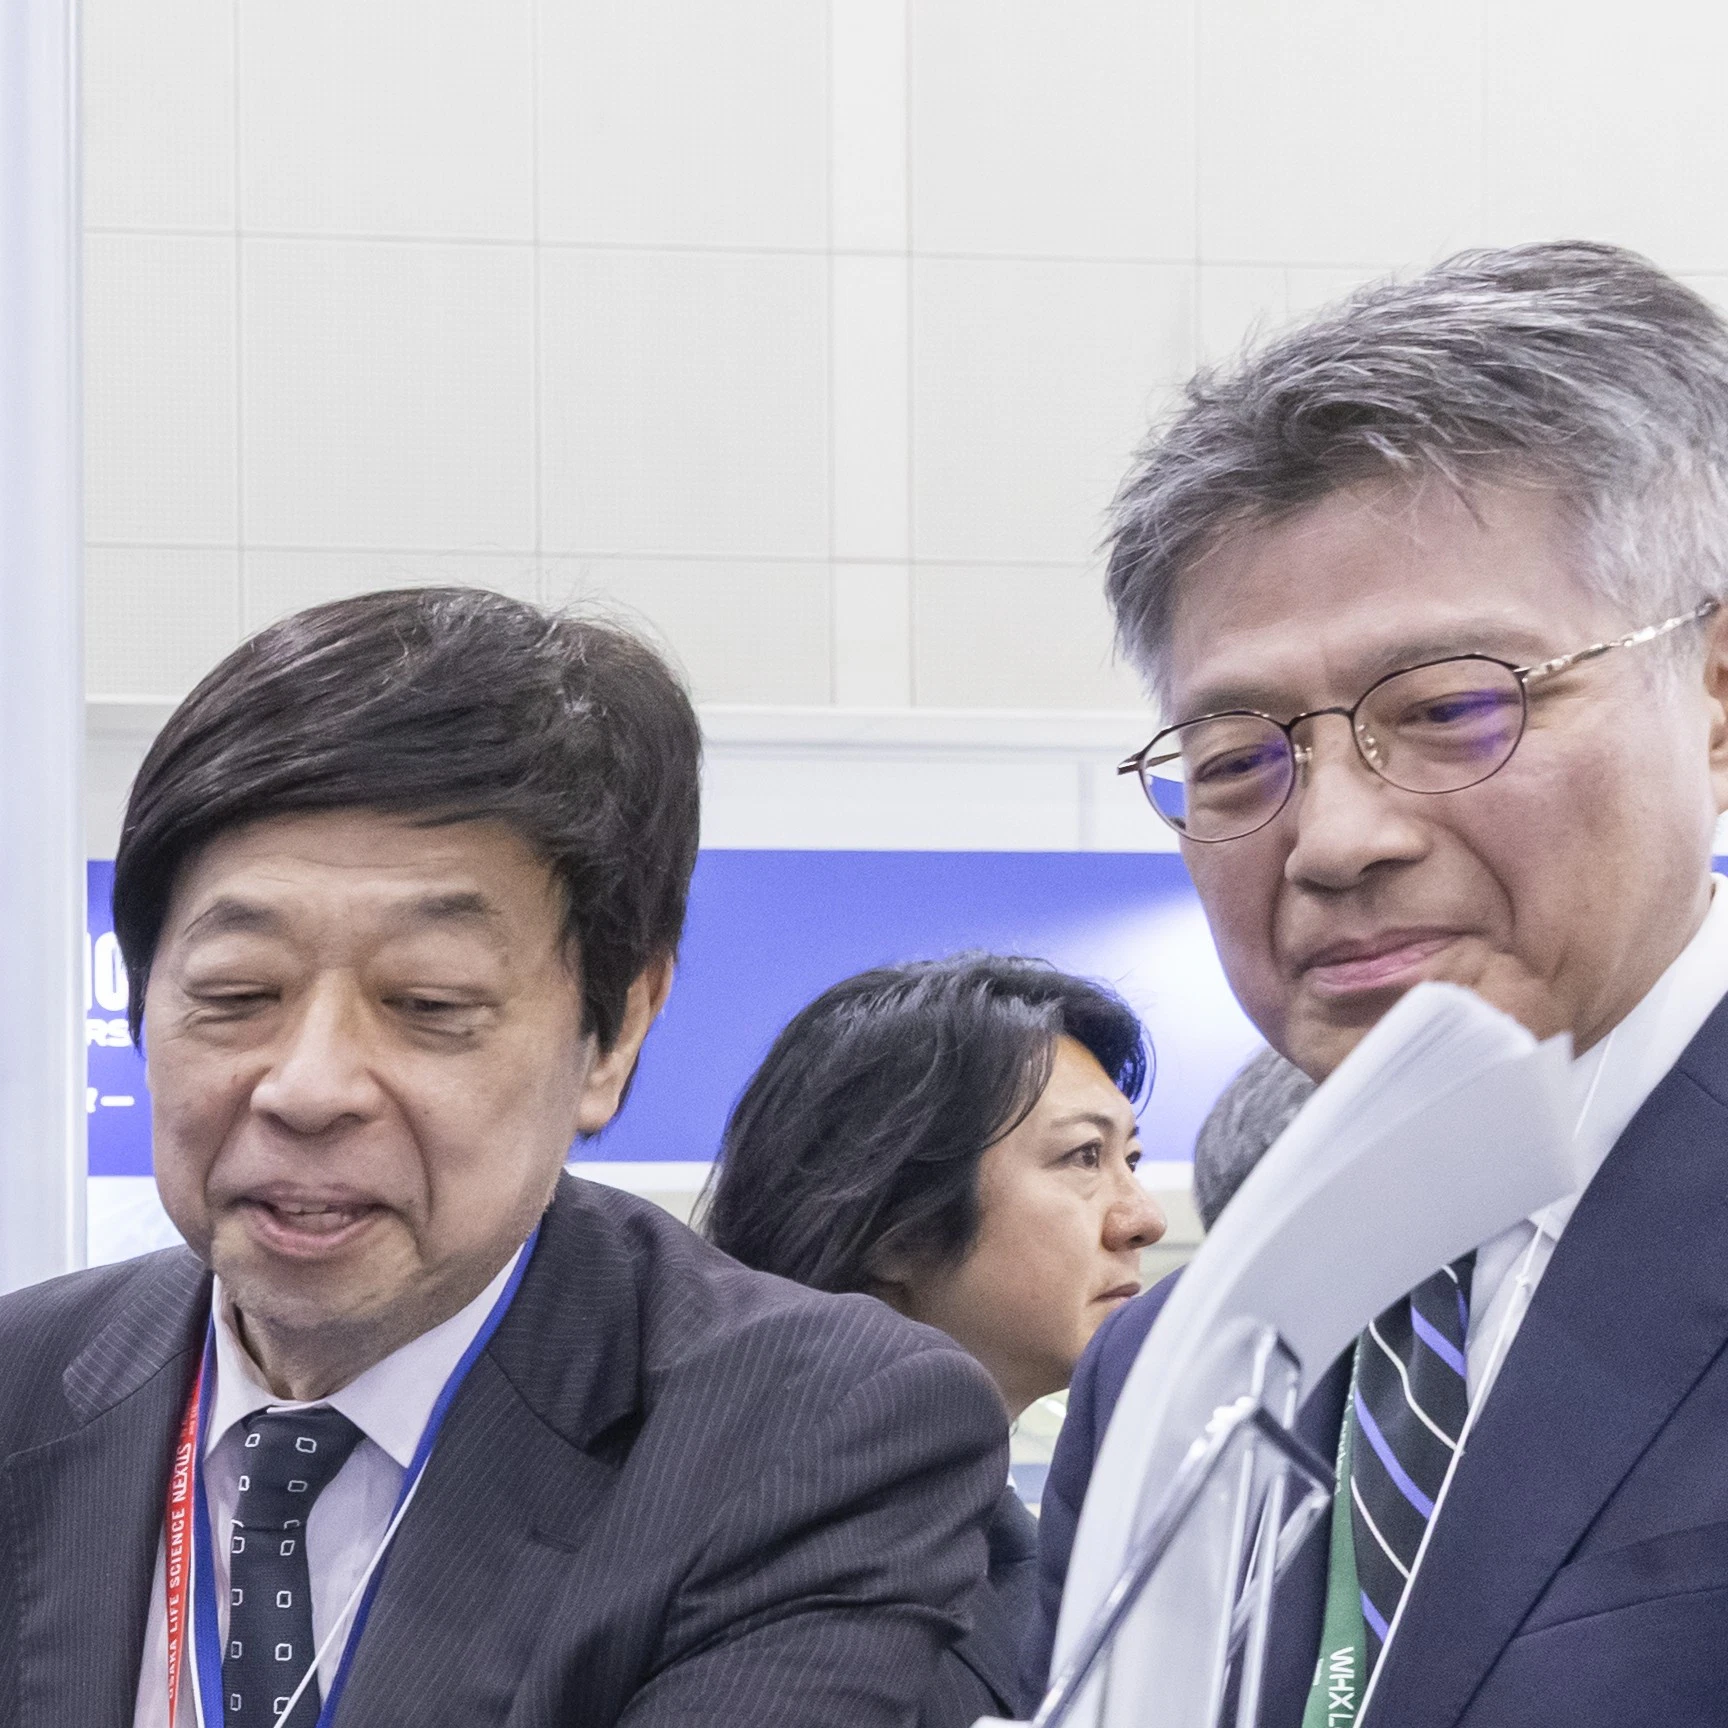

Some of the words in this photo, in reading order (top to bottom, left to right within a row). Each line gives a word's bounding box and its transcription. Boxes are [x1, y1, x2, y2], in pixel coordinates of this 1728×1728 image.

[172, 1442, 192, 1503] NEXUS
[170, 1508, 185, 1589] SCIENCE
[170, 1593, 180, 1633] LIFE
[1328, 1647, 1355, 1711] WHX
